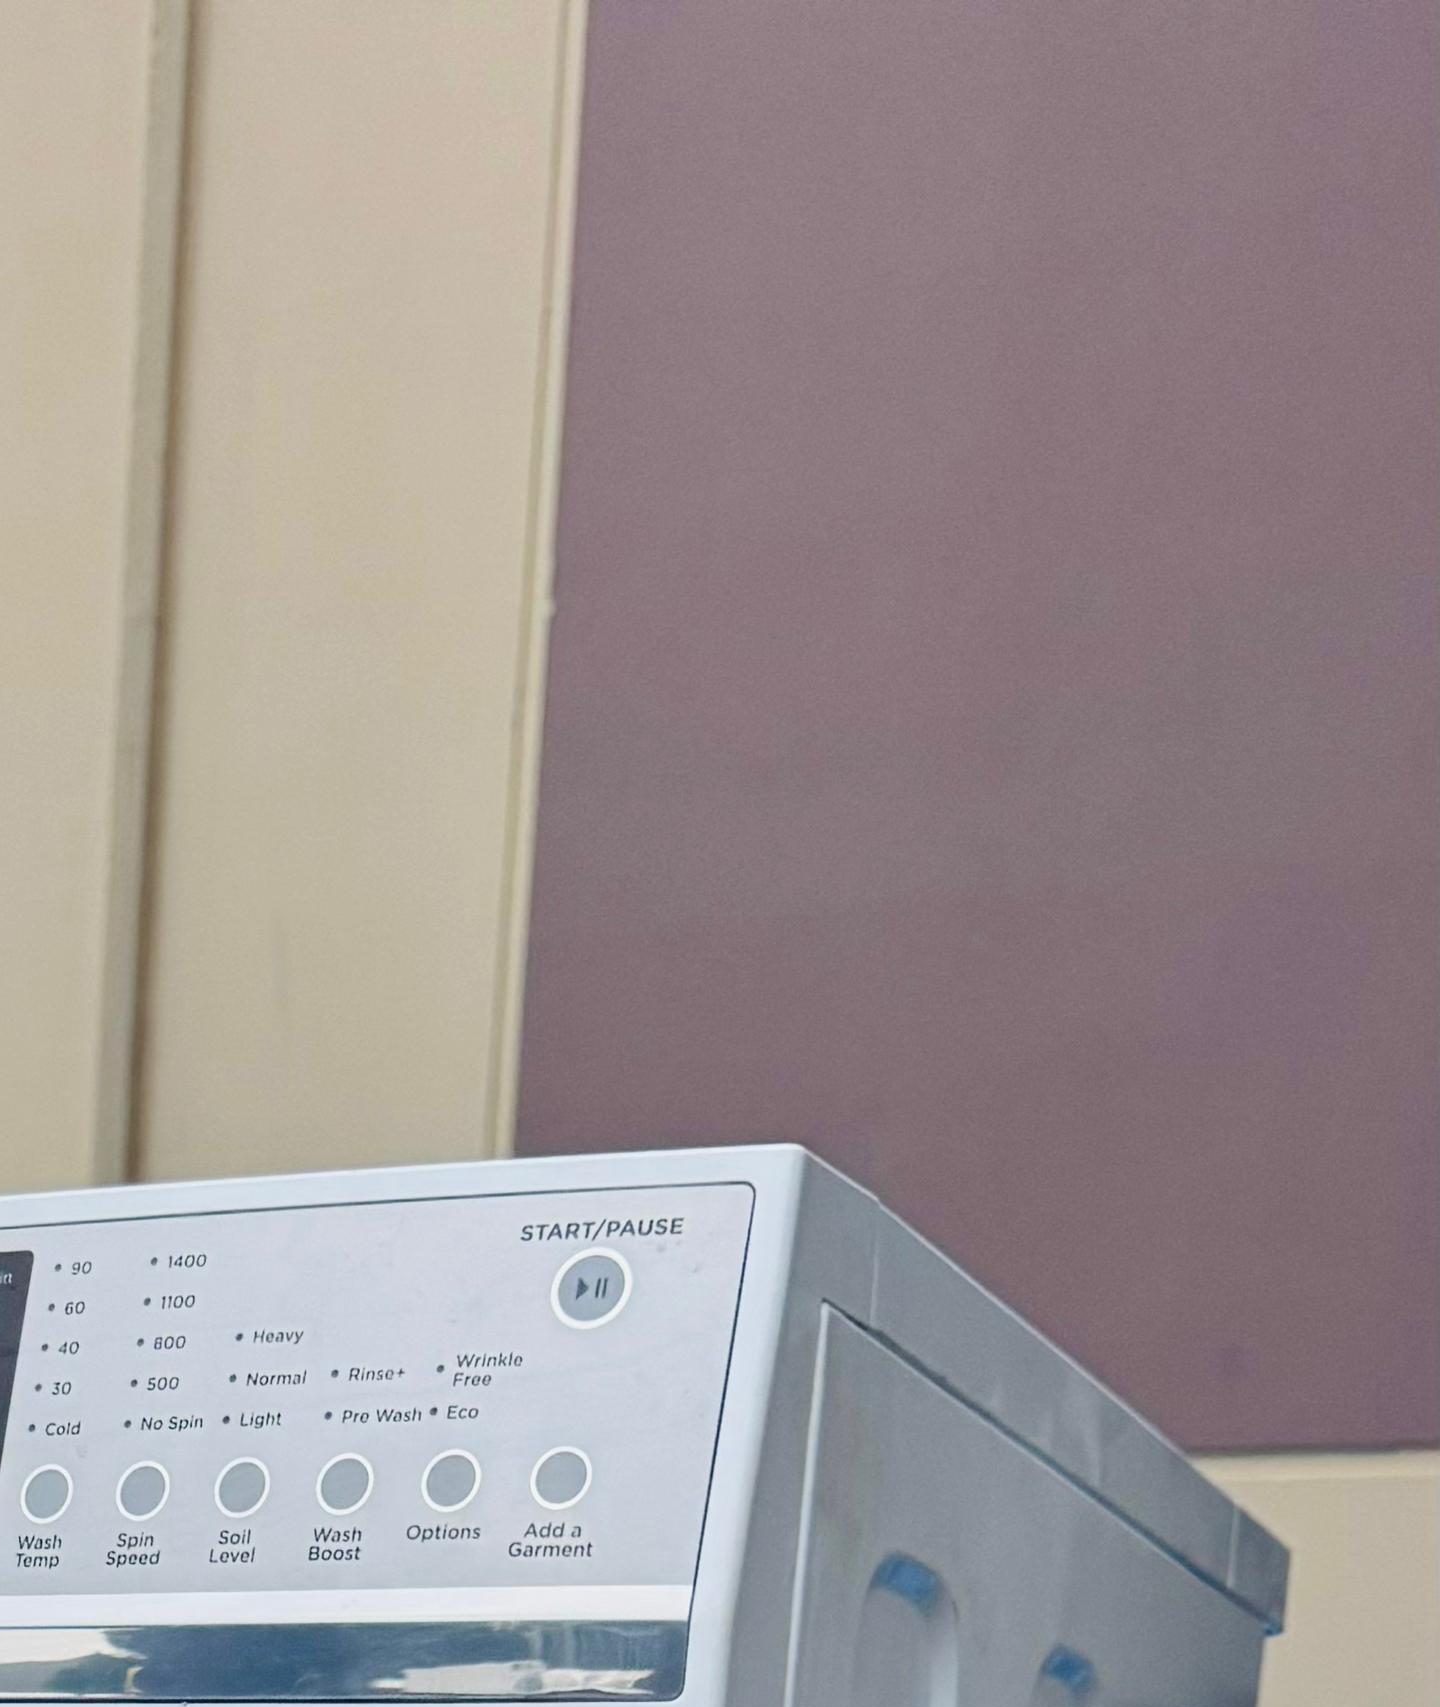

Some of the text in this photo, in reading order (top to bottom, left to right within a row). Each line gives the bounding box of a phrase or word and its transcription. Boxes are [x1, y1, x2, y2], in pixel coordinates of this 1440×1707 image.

[520, 1217, 685, 1243] START/PAUSE
[70, 1260, 93, 1276] 90
[167, 1253, 208, 1270] 1400
[64, 1301, 86, 1316] 60
[160, 1294, 196, 1310] 1100
[153, 1334, 187, 1351] 800
[252, 1328, 305, 1347] Heavy
[58, 1341, 81, 1356] 40
[456, 1351, 524, 1370] Wrinkle
[146, 1375, 180, 1391] 500
[246, 1368, 308, 1386] Normal
[347, 1366, 406, 1383] Rinse+
[452, 1370, 492, 1387] Free
[51, 1381, 73, 1396] 30
[239, 1410, 282, 1430] Light
[341, 1406, 423, 1424] Pre Wash
[446, 1403, 480, 1420] Eco
[45, 1421, 82, 1437] Cold
[140, 1414, 204, 1433] No Spin
[218, 1529, 252, 1546] Soil
[312, 1526, 363, 1545] Wash
[405, 1523, 482, 1545] Options
[523, 1522, 583, 1540] Add a
[17, 1534, 63, 1551] Wash
[116, 1531, 154, 1550] Spin
[105, 1549, 161, 1569] Speed
[209, 1546, 257, 1564] Level
[308, 1543, 362, 1562] Boost
[508, 1540, 594, 1560] Garment
[16, 1552, 60, 1570] Temp
